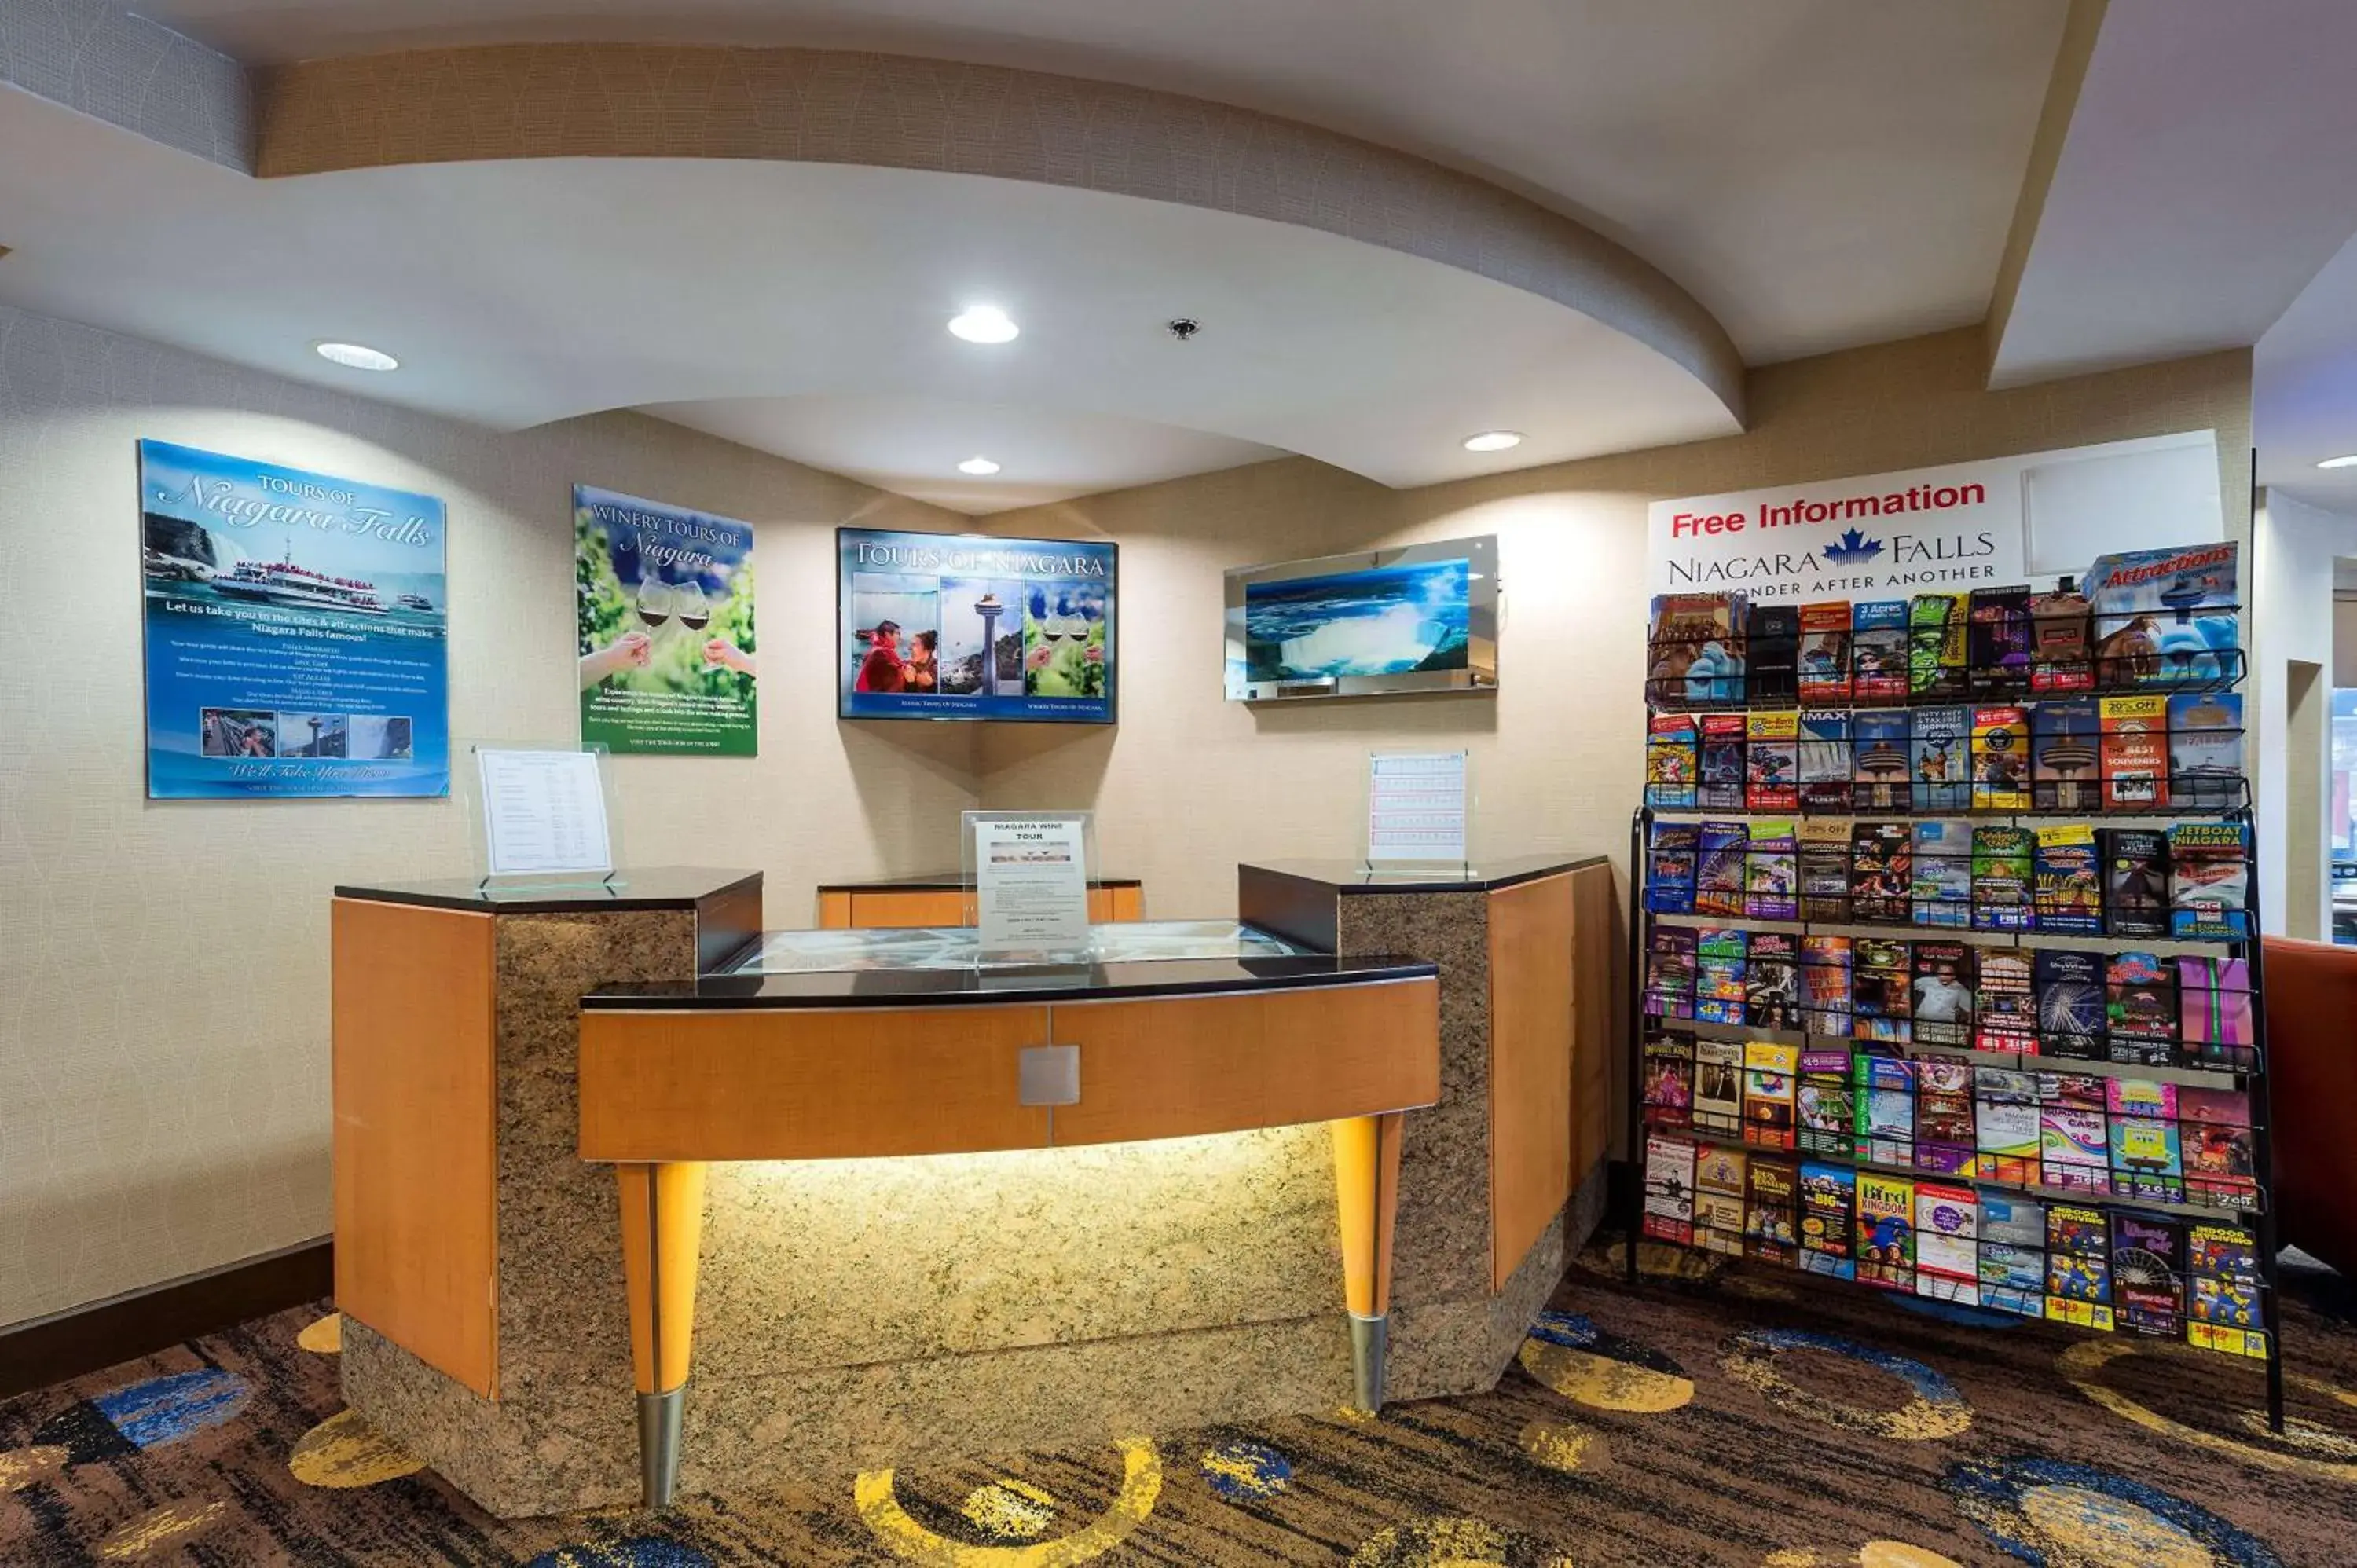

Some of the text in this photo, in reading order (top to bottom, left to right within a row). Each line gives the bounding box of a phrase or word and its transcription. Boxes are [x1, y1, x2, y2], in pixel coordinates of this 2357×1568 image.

[258, 475, 354, 505] TOURS OF
[157, 474, 431, 548] Niagara Falls
[1672, 483, 1985, 538] Free Information
[593, 504, 739, 546] WINERY TOURS OF
[620, 532, 713, 566] Niagara
[857, 543, 1105, 576] TOURS OF NIAGARA
[1668, 531, 1996, 585] NIAGARA FALLS
[2106, 546, 2231, 588] Attractions
[1812, 575, 1875, 593] AFTER
[1887, 564, 1996, 587] ANOTHER
[1861, 603, 1901, 614] 3 Acres
[166, 601, 188, 613] Let
[189, 605, 203, 614] us
[206, 606, 232, 617] take
[236, 610, 257, 620] you
[320, 617, 328, 627] &
[331, 619, 384, 633] attractions
[408, 628, 434, 639] make
[252, 622, 367, 642] Niagara Falls famous!
[1802, 711, 1847, 721] IMAX
[1916, 722, 1963, 731] SHOPPING
[2126, 746, 2155, 754] BEST
[2106, 757, 2161, 766] SOUVENIRS
[993, 822, 1036, 830] NIAGARA
[2177, 826, 2242, 837] JETBOAT
[2176, 835, 2241, 846] NIAGARA
[2067, 1118, 2100, 1130] CARS
[1815, 1192, 1837, 1207] BIG
[1861, 1196, 1908, 1216] KINGDOM
[2048, 1211, 2106, 1225] SKYDIVING
[2053, 1206, 2099, 1218] INDOOR
[2190, 1231, 2254, 1247] SKYDIVING
[2195, 1225, 2245, 1240] INDOOR
